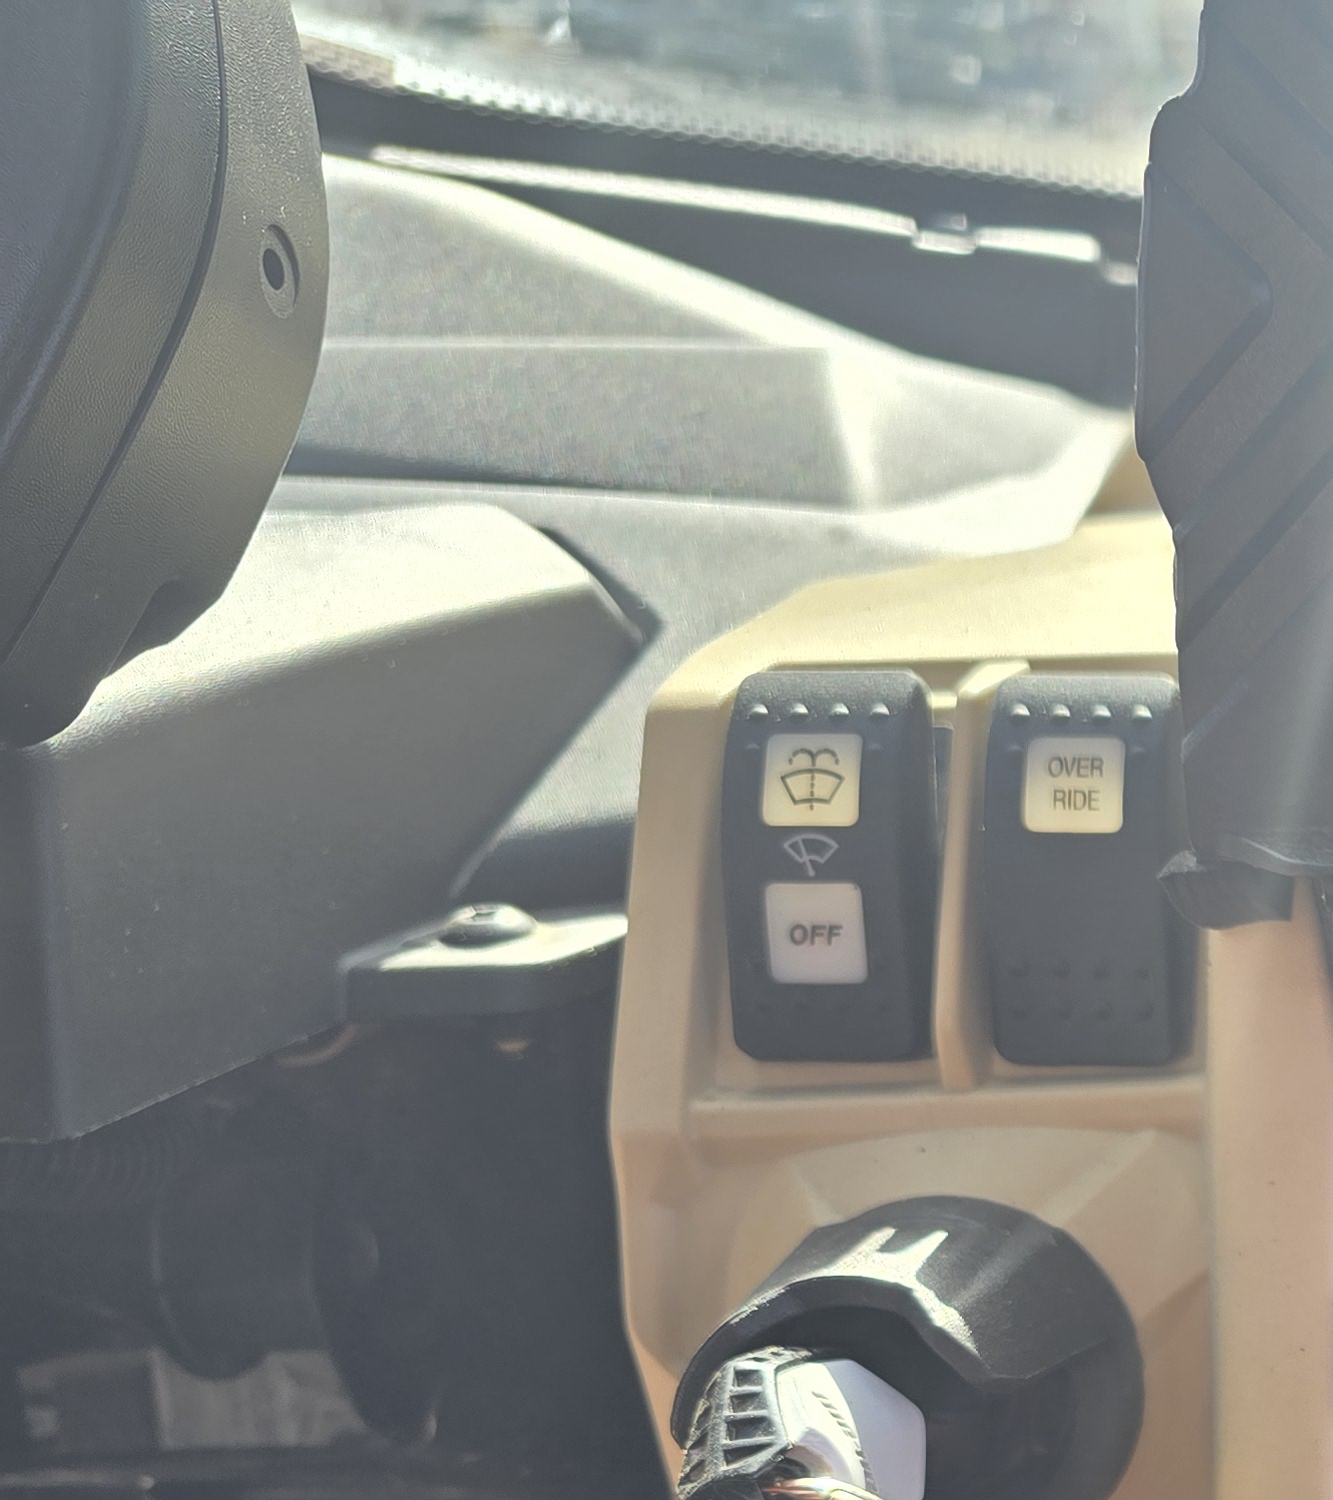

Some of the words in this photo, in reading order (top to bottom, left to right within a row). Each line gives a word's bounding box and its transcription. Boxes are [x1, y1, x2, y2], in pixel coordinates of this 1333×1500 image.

[1048, 756, 1104, 778] OVER
[1053, 788, 1100, 811] RIDE
[789, 923, 844, 946] OFF
